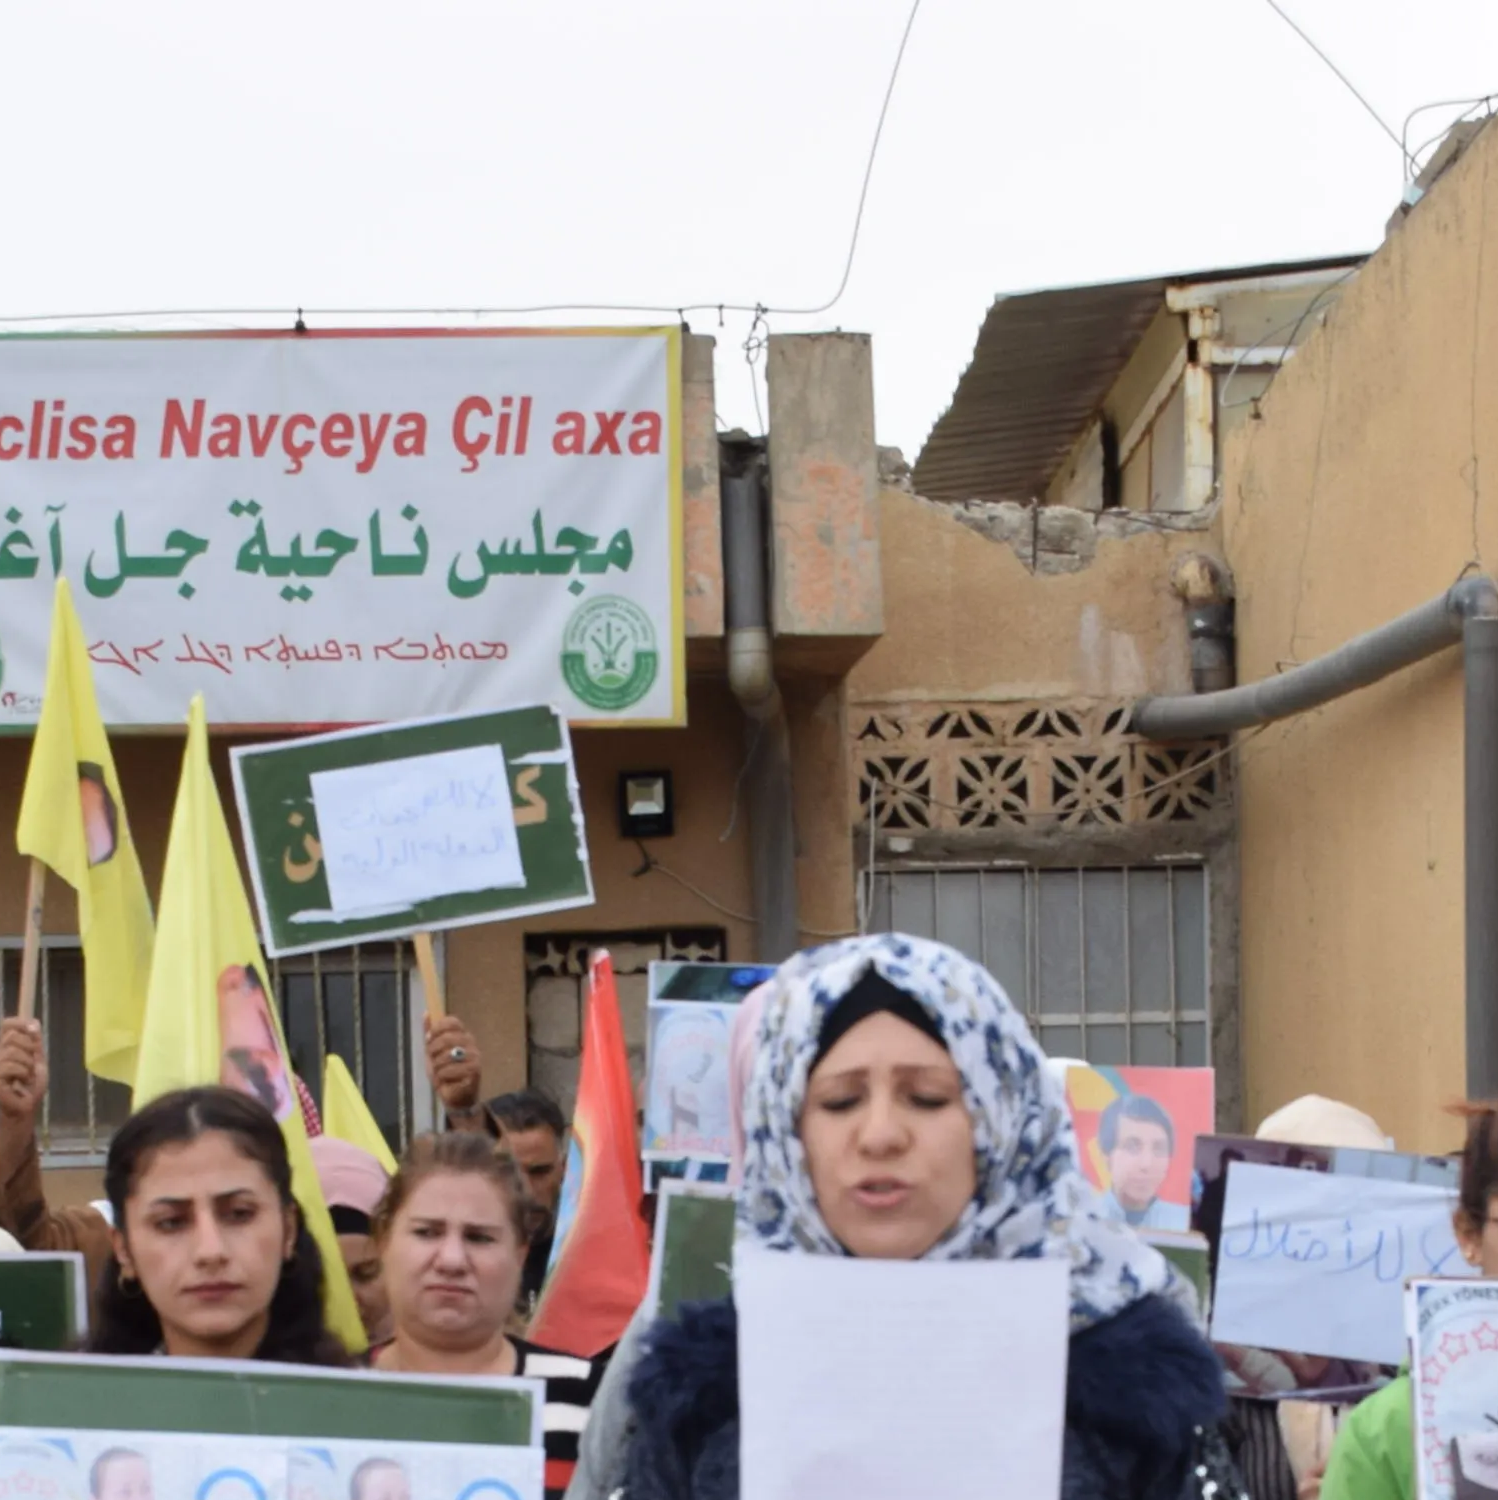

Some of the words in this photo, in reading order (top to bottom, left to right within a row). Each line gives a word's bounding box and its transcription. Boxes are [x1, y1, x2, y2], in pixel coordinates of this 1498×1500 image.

[159, 399, 427, 474] Navçeya
[451, 396, 531, 472] Çil
[551, 409, 661, 455] axa
[82, 510, 209, 600] جل
[228, 500, 429, 602] ناحية
[445, 508, 634, 598] مجلس
